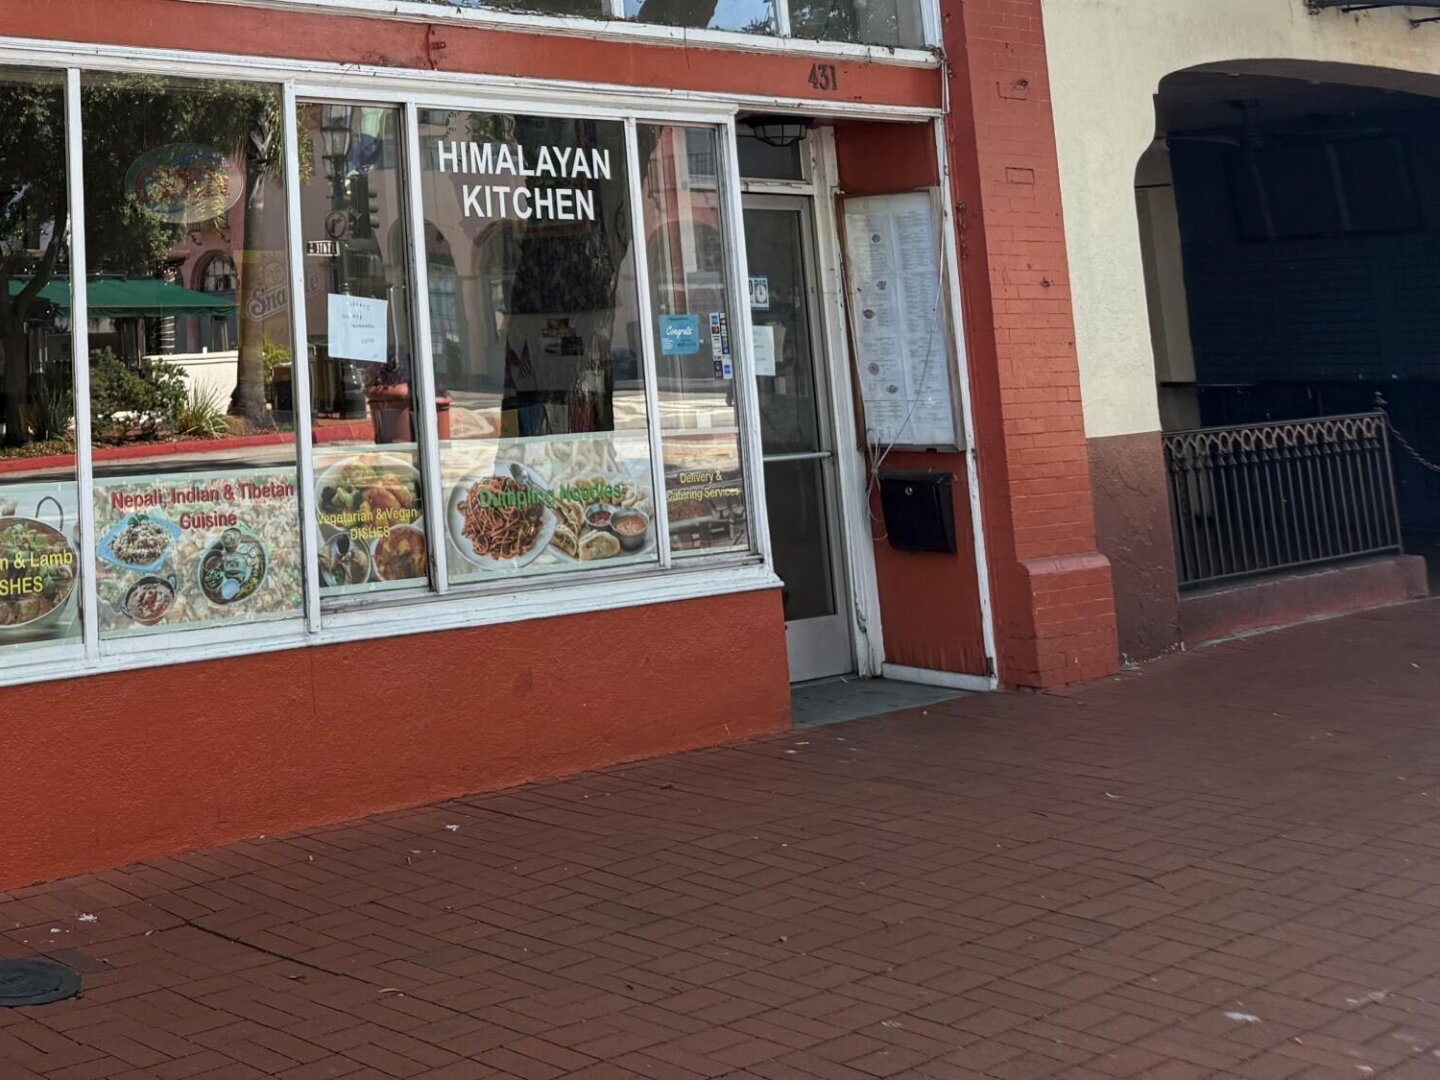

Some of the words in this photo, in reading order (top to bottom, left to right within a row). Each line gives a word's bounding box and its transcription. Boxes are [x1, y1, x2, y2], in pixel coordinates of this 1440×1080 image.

[808, 63, 838, 91] 431
[437, 140, 611, 180] HIMALAYAN
[462, 184, 595, 220] KITCHEN
[679, 472, 713, 484] Delivery
[716, 471, 723, 481] &
[111, 489, 167, 509] Nepali,
[171, 487, 219, 504] Indian
[223, 484, 235, 501] &
[239, 482, 295, 499] Tibetan
[560, 483, 624, 502] Noodles
[667, 488, 703, 502] Catering
[704, 487, 739, 498] Services
[179, 510, 237, 530] Cuisine
[318, 510, 373, 525] Vegetarian
[376, 508, 385, 520] &
[386, 508, 417, 521] Vegan
[350, 525, 390, 541] DISHES
[14, 553, 26, 570] &
[31, 548, 73, 568] Lamb
